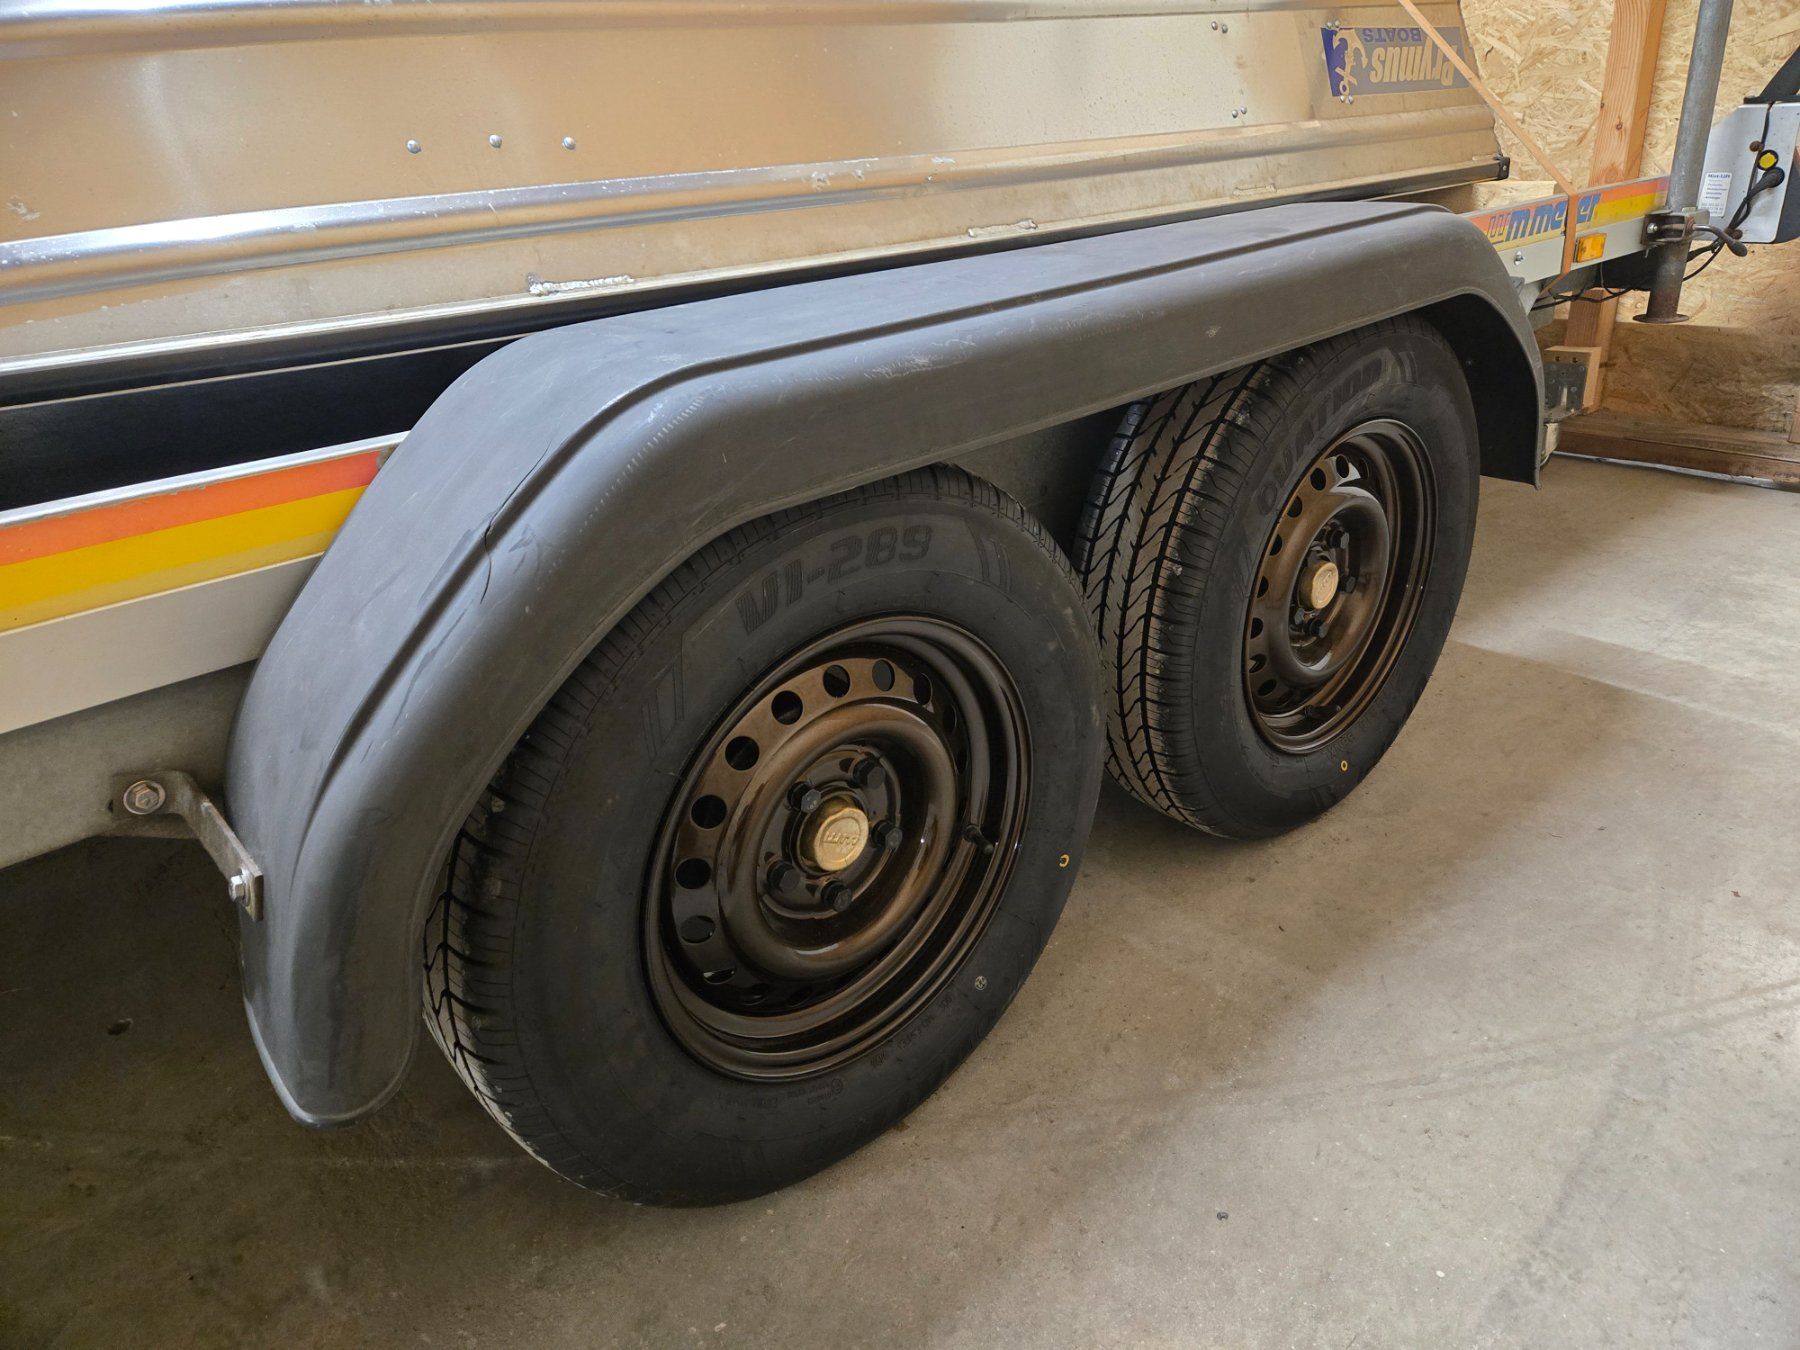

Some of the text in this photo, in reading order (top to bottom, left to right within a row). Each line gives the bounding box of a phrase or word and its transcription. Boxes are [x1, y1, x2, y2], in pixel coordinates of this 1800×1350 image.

[1362, 28, 1422, 43] BOATS
[1370, 37, 1458, 86] Prymus
[736, 525, 933, 635] VI-289
